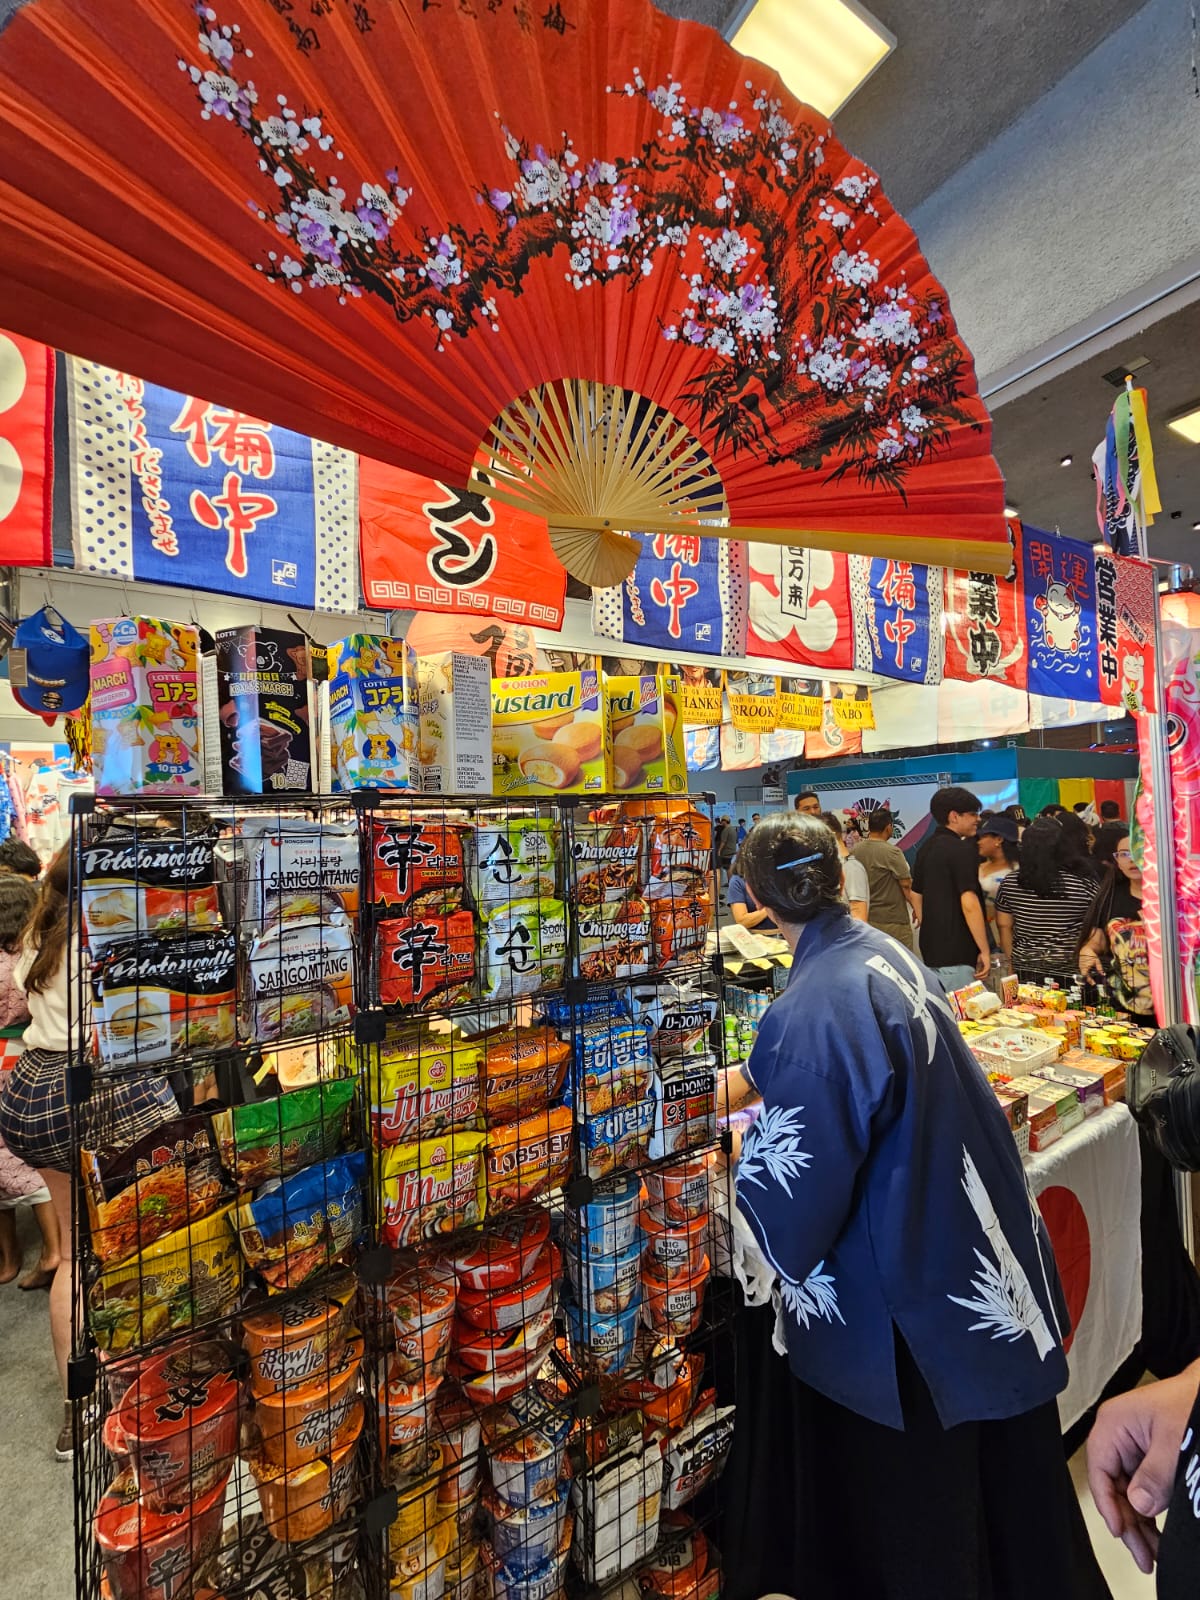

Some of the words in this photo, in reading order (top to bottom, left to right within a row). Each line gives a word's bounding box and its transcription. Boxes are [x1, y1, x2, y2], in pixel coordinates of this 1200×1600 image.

[216, 630, 237, 639] LOTTE
[93, 671, 128, 691] MARCH
[151, 674, 182, 682] LOTTE
[363, 681, 388, 689] LOTTE
[511, 679, 548, 690] ORION
[262, 682, 294, 697] MARCH
[492, 686, 575, 714] ustard
[732, 704, 775, 718] BROOK
[836, 707, 863, 720] SABO
[524, 835, 546, 848] SOON
[377, 823, 436, 895] 辛
[426, 854, 459, 870] 라면
[169, 866, 206, 880] soup
[270, 869, 359, 889] SARIGOMTANG
[392, 922, 451, 996] 辛
[440, 951, 472, 967] 라면
[194, 967, 229, 984] soup
[258, 957, 348, 991] SARIGOMTANG
[668, 1076, 712, 1099] U-DONG
[384, 1081, 433, 1129] Jin
[490, 1132, 571, 1175] LOBSTER
[387, 1170, 436, 1226] Jin
[658, 1247, 684, 1255] BOWL
[662, 1240, 680, 1249] BIG
[673, 1293, 691, 1304] BIG
[592, 1336, 619, 1346] BOWL
[263, 1337, 313, 1365] Bowl
[258, 1351, 324, 1380] Noodle
